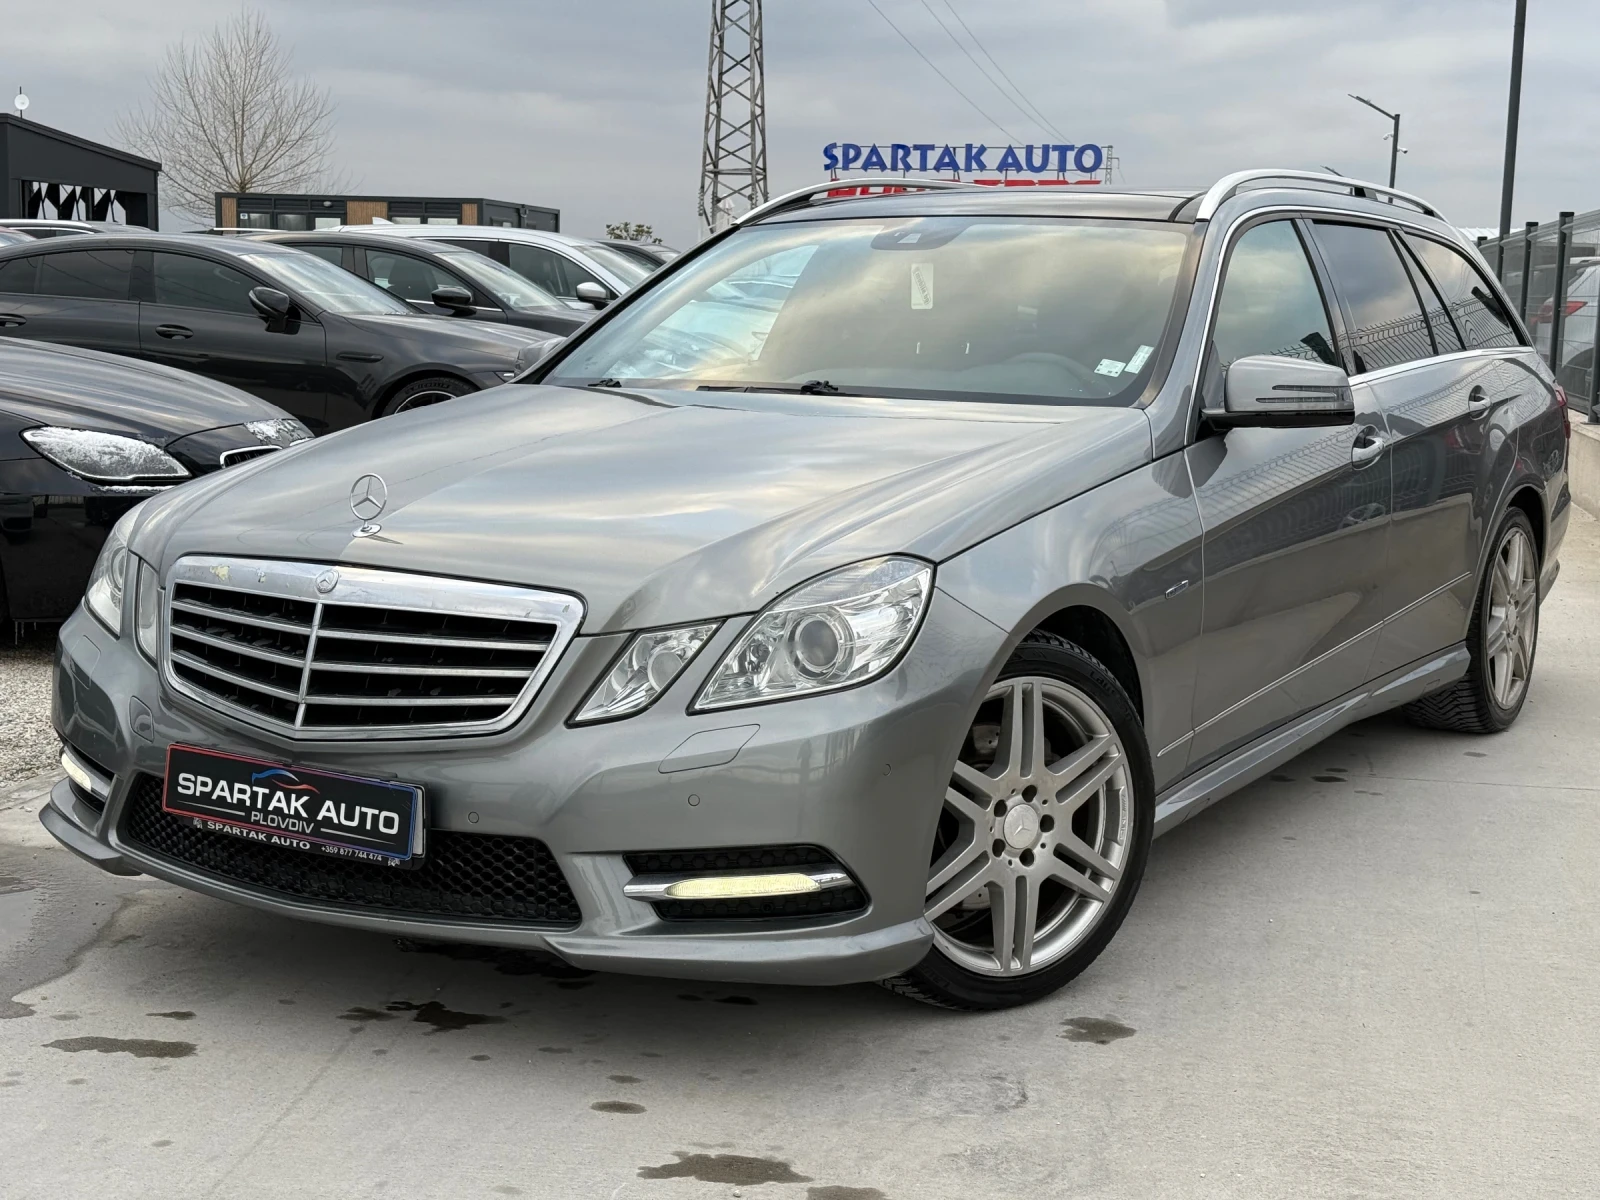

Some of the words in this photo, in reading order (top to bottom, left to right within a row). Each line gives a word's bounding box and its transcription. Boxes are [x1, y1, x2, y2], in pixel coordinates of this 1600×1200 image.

[823, 142, 987, 172] SPARTAK
[997, 144, 1103, 173] AUTO
[177, 772, 311, 818] SPARTAK
[316, 800, 400, 835] AUTO
[207, 821, 267, 841] SPARTAK
[271, 835, 310, 850] AUTO
[250, 811, 314, 834] PLOVDIV
[321, 845, 338, 854] +359
[340, 848, 353, 857] 877
[355, 850, 367, 859] 744
[368, 853, 382, 861] 474
